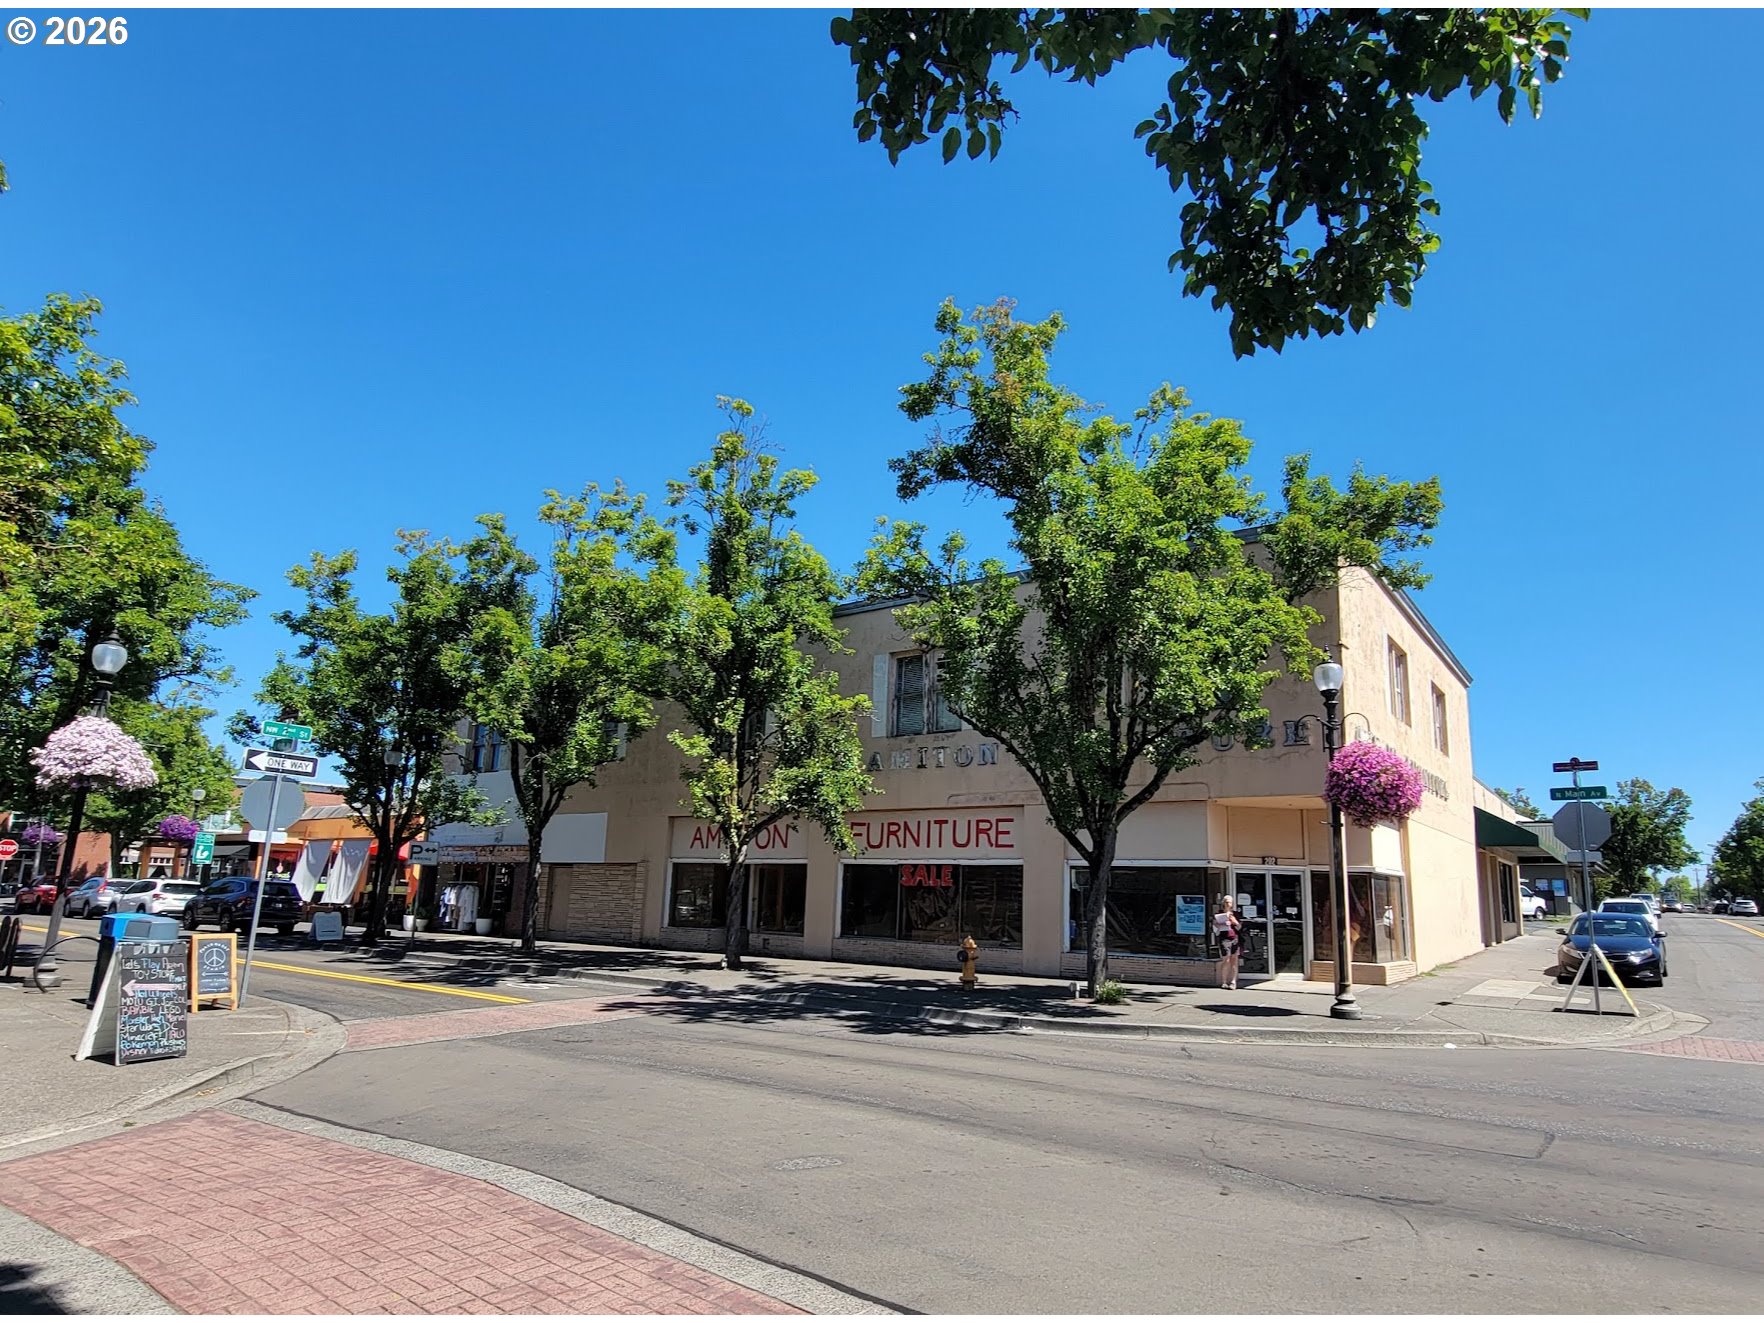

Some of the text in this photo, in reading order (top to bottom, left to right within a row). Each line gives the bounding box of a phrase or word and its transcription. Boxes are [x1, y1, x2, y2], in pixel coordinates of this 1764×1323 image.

[265, 726, 278, 734] NW
[282, 726, 296, 736] 2nd
[267, 758, 310, 771] ONE WAY
[1565, 790, 1586, 798] Main
[690, 818, 1015, 850] AMON FURNITURE
[901, 865, 953, 887] SALE
[142, 957, 160, 971] Play
[131, 969, 150, 980] TOY
[159, 1005, 181, 1014] LEGO
[120, 1024, 139, 1033] Star
